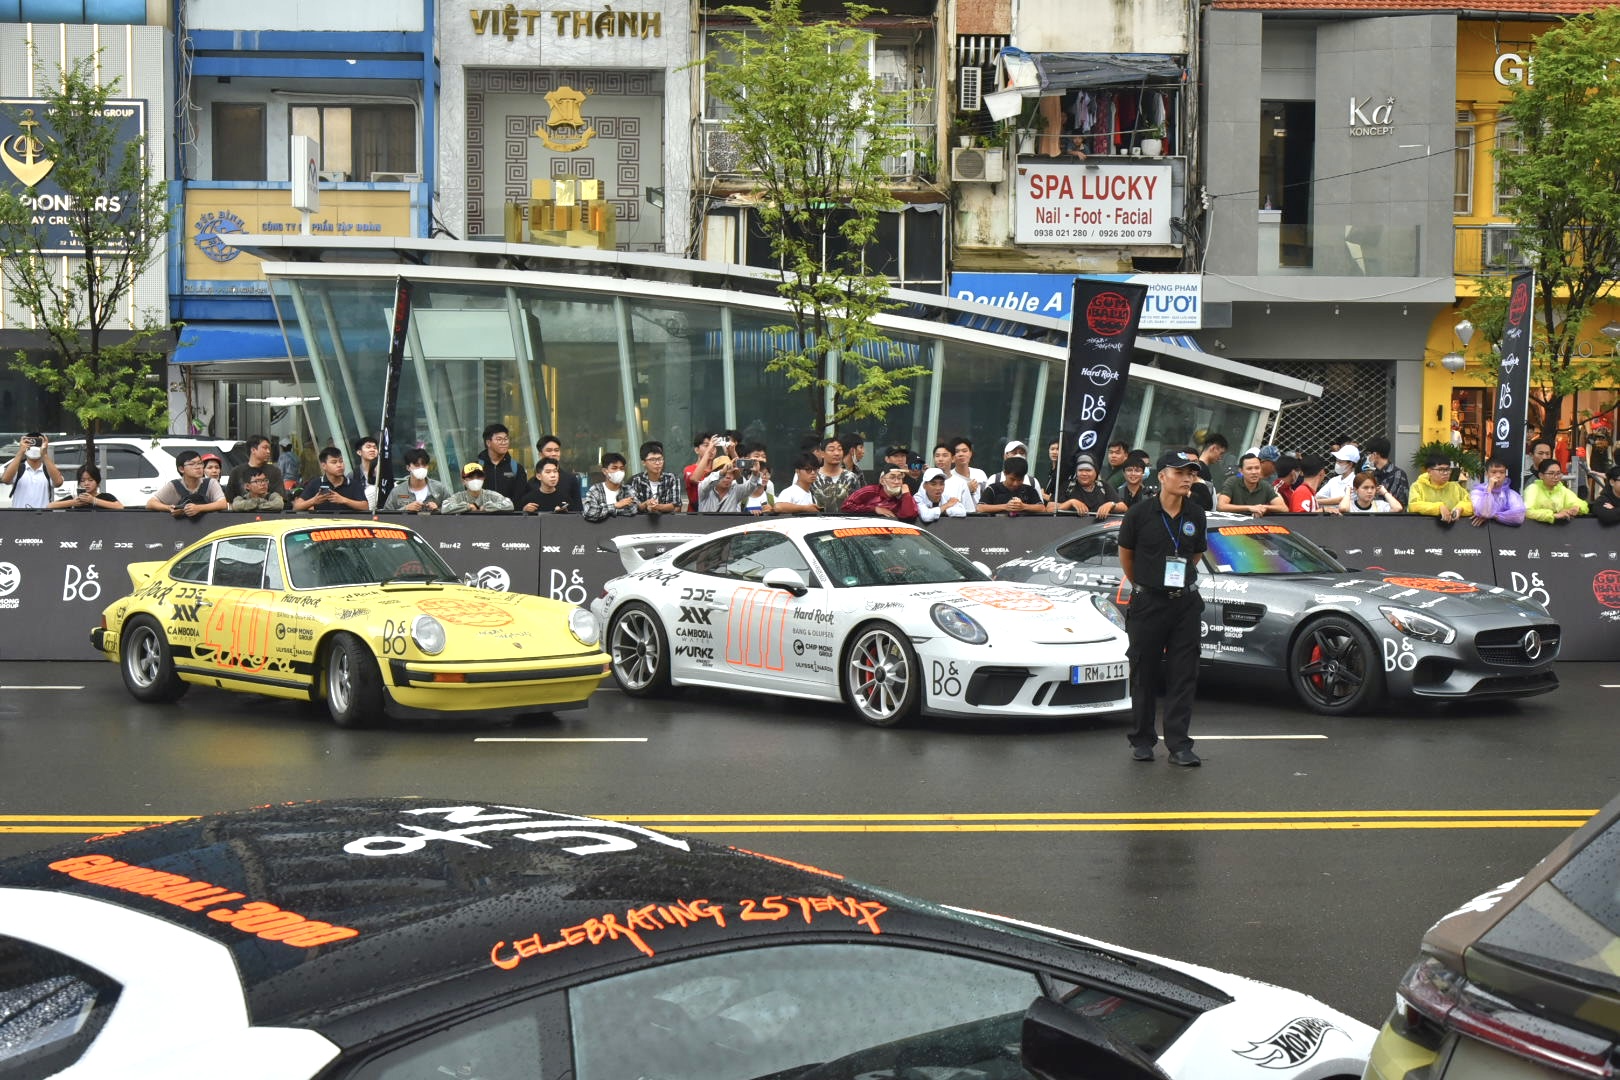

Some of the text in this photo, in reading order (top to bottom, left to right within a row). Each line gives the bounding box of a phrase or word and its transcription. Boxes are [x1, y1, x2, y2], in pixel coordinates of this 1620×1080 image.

[471, 4, 661, 41] VIỆT THÀNH
[104, 109, 134, 117] GROUP
[1350, 126, 1394, 136] KONCEPT
[1030, 174, 1157, 200] SPA LUCKY
[31, 216, 46, 225] AY
[1036, 207, 1060, 224] Nail
[1074, 207, 1102, 225] Foot
[1115, 208, 1152, 225] Facial
[286, 223, 296, 231] TY
[1034, 229, 1053, 237] 0938
[1056, 229, 1070, 237] 021
[1072, 229, 1087, 237] 280
[1098, 230, 1118, 238] 0926
[1120, 230, 1135, 238] 200
[1137, 230, 1152, 238] 079
[1043, 292, 1062, 311] A
[1146, 295, 1196, 313] TƯƠI
[1081, 367, 1119, 381] Hard Rock
[311, 528, 408, 542] GUMBALL 3000
[833, 527, 891, 538] GUMBALL
[1223, 580, 1248, 593] Rock
[281, 594, 321, 608] Hard Rock
[794, 606, 834, 625] Hard Rock
[167, 625, 200, 637] CAMBODIA
[287, 626, 313, 636] CHIP MONG
[676, 627, 713, 639] CAMBODIA
[792, 628, 807, 636] BANG
[675, 645, 714, 659] WURKZ
[1085, 666, 1099, 681] RM
[1113, 664, 1124, 678] 11
[48, 854, 246, 913] GUMBALL
[490, 899, 726, 970] CELEBRATING
[739, 895, 790, 921] 25
